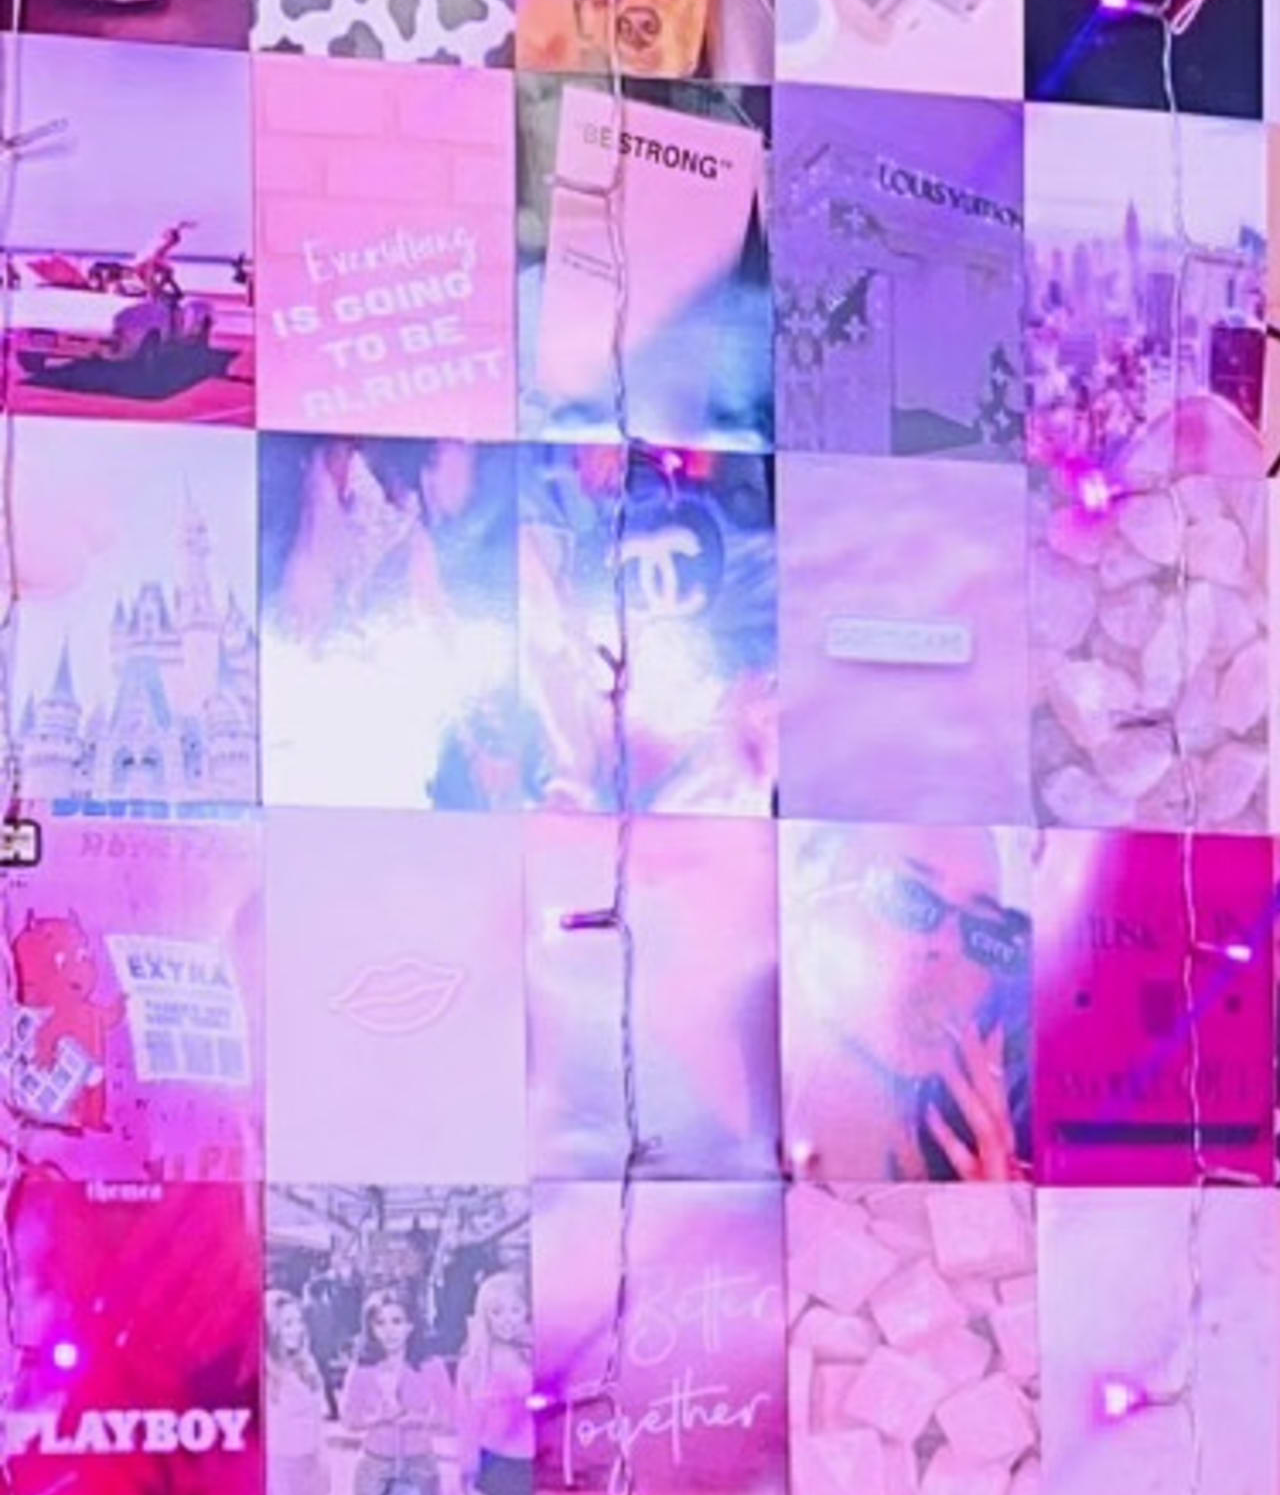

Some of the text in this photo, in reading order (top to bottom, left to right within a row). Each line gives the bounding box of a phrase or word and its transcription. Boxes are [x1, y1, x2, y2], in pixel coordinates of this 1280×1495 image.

[272, 268, 473, 339] IS GOING
[323, 314, 466, 369] TO BE
[4, 1408, 251, 1456] PLAYBOY
